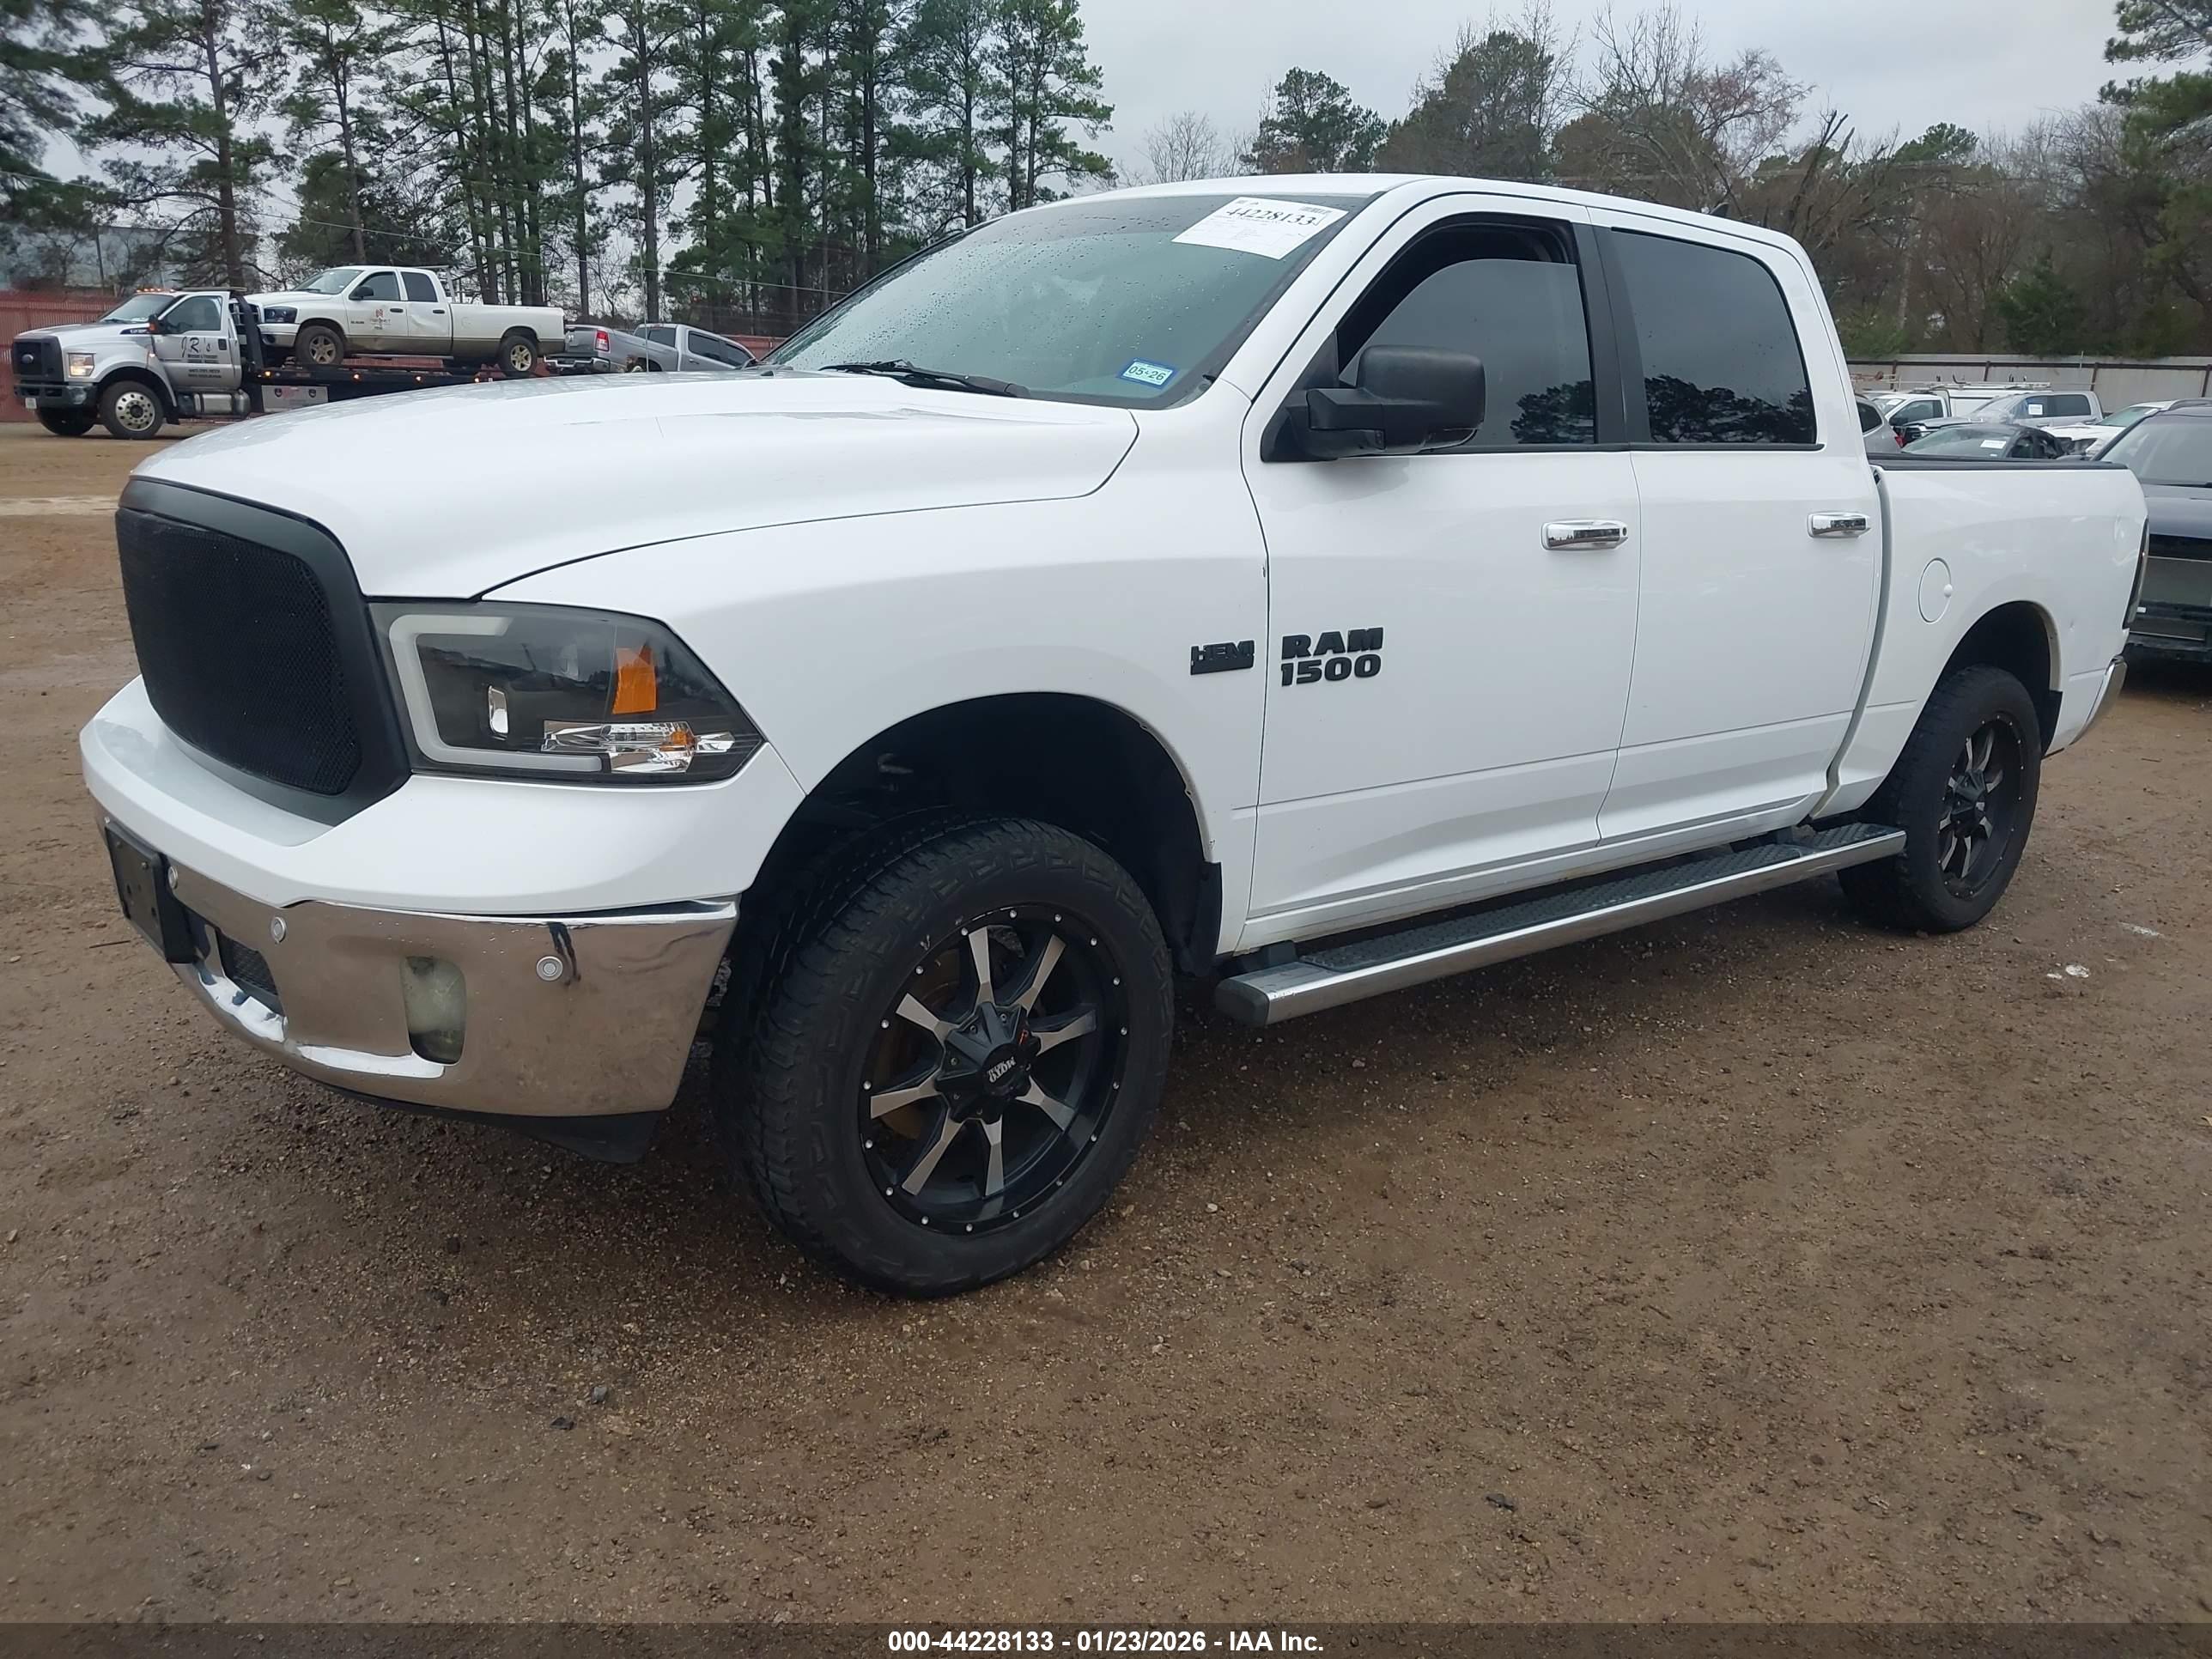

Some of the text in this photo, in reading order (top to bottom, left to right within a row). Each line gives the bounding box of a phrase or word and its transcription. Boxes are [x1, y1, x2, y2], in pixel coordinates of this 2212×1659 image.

[1226, 207, 1317, 225] 44228133
[1281, 627, 1384, 659] RAM
[1281, 653, 1382, 687] 1500
